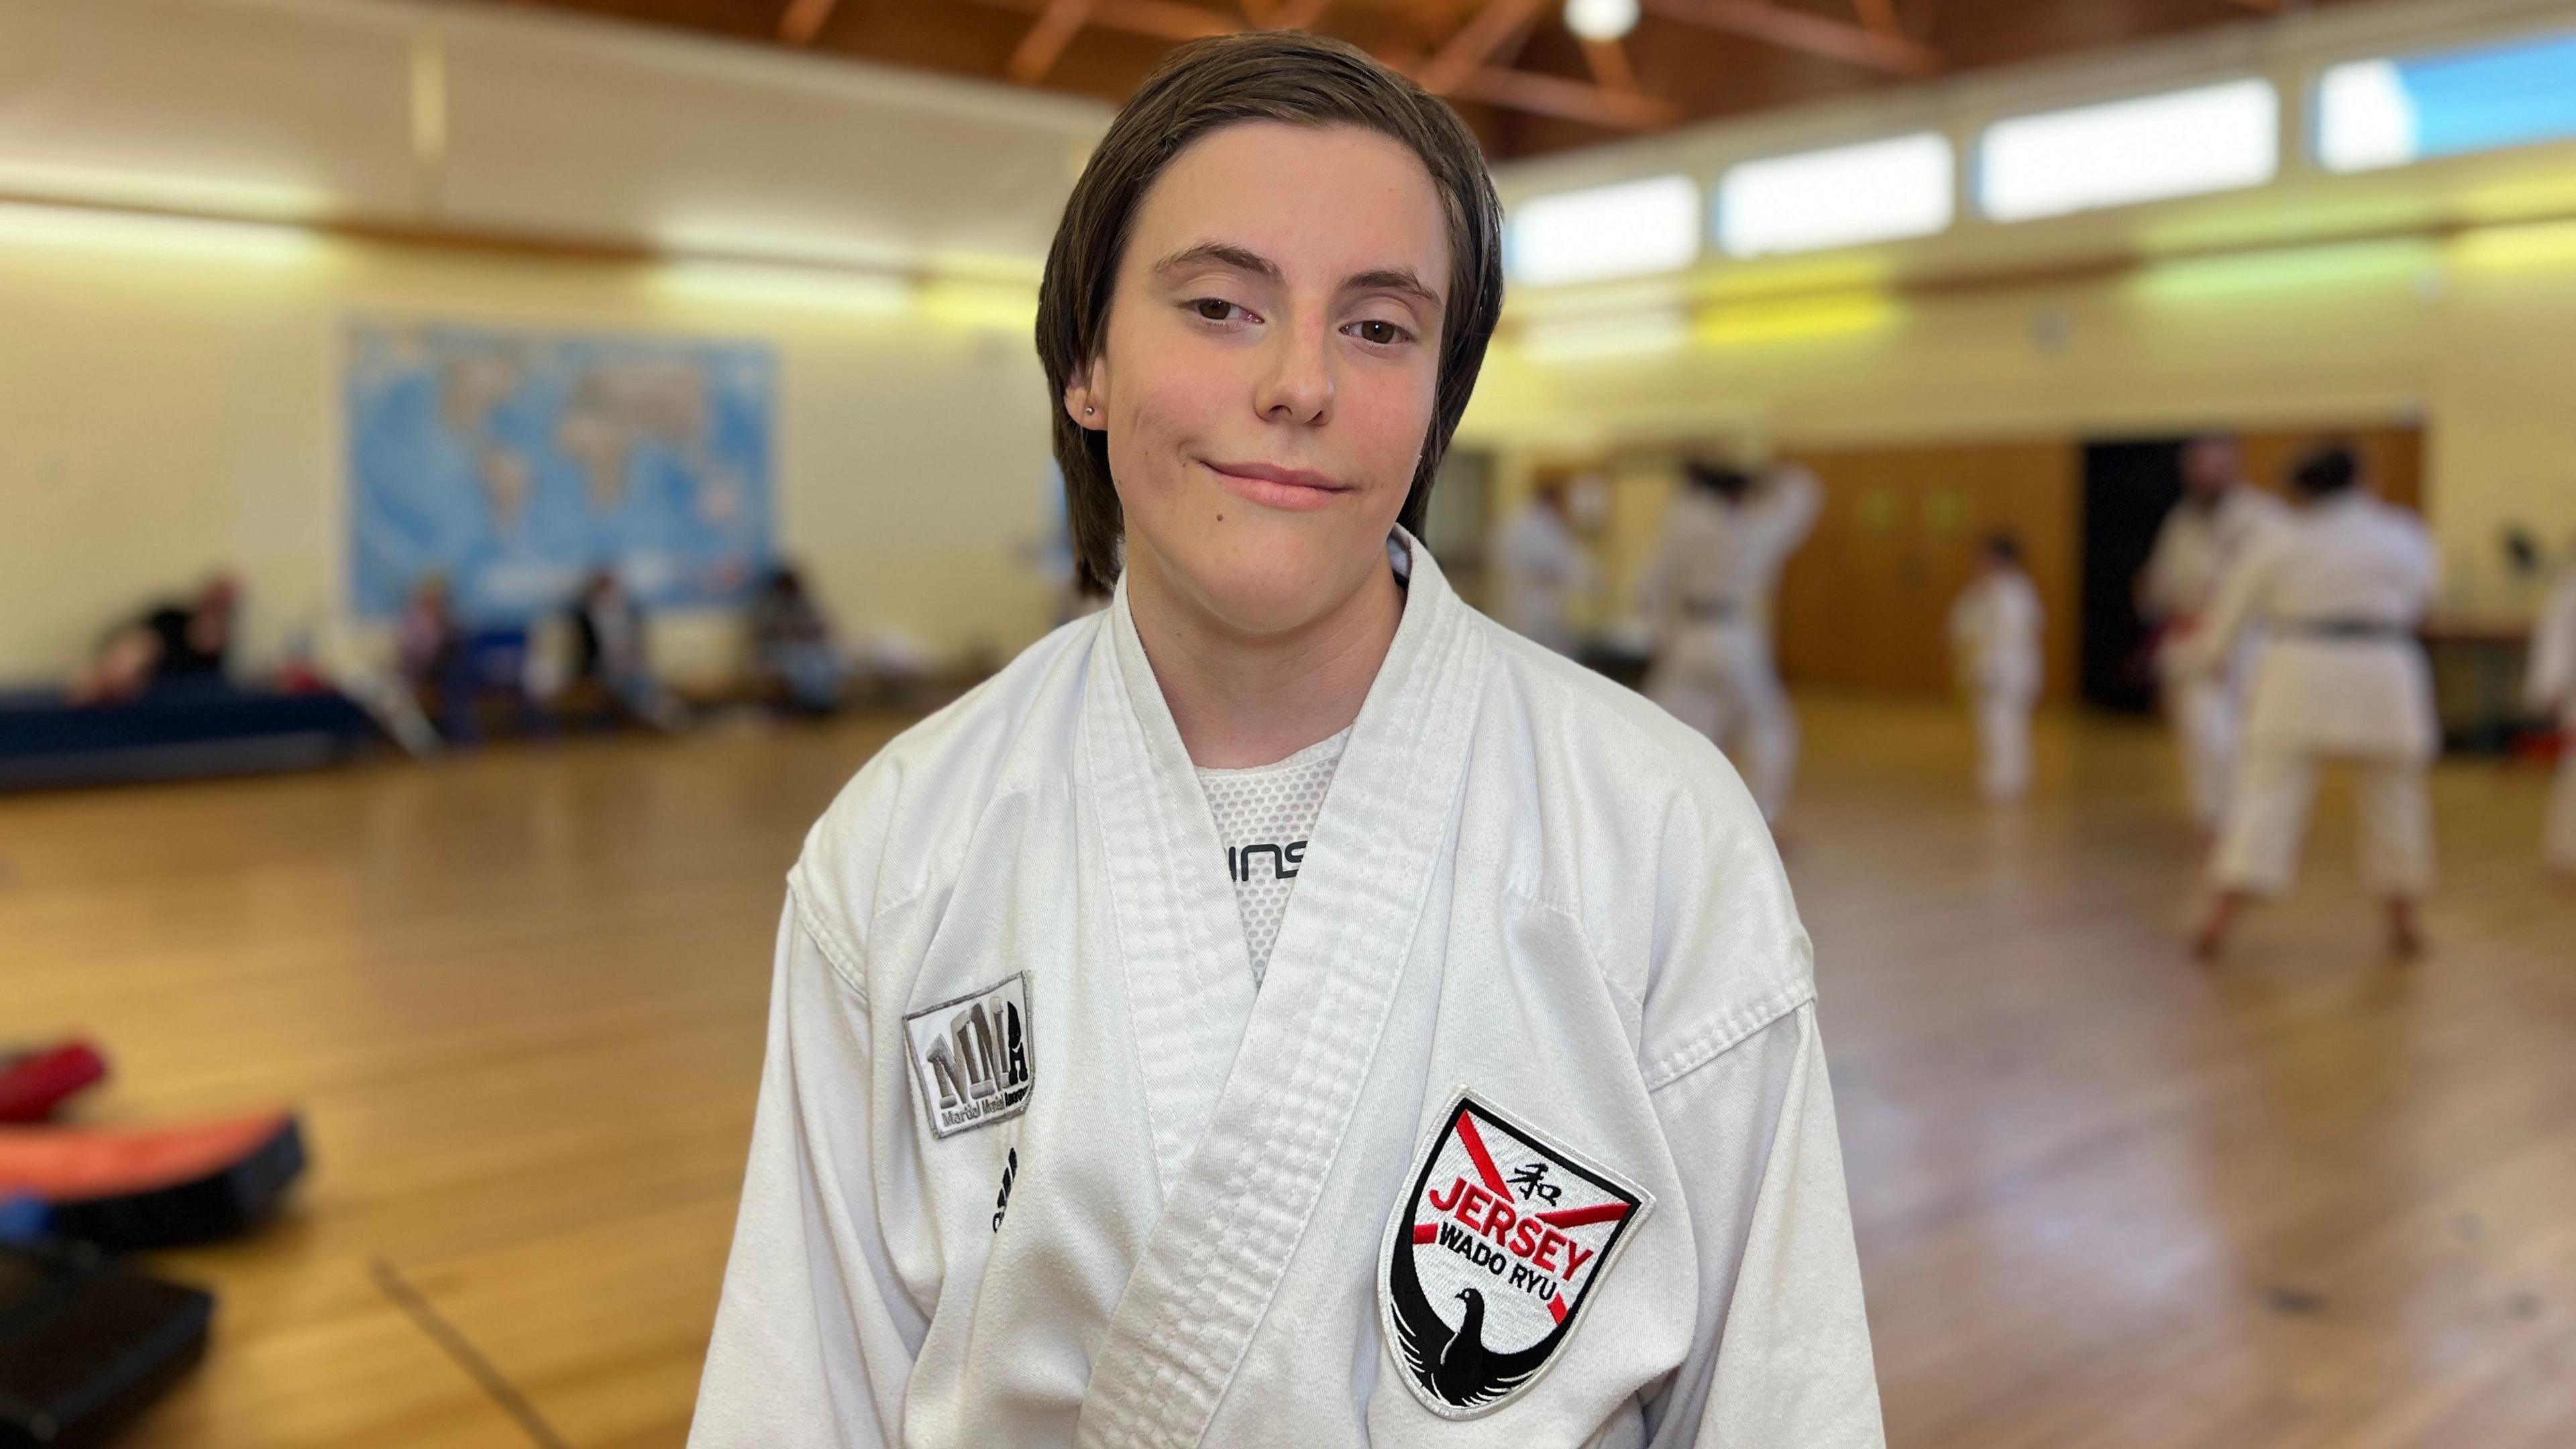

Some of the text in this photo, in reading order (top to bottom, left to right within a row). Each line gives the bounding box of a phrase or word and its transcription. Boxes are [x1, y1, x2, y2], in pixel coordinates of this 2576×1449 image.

[1506, 1163, 1562, 1208] 和
[1428, 1176, 1595, 1281] JERSEY
[1438, 1220, 1558, 1301] WADO RYU
